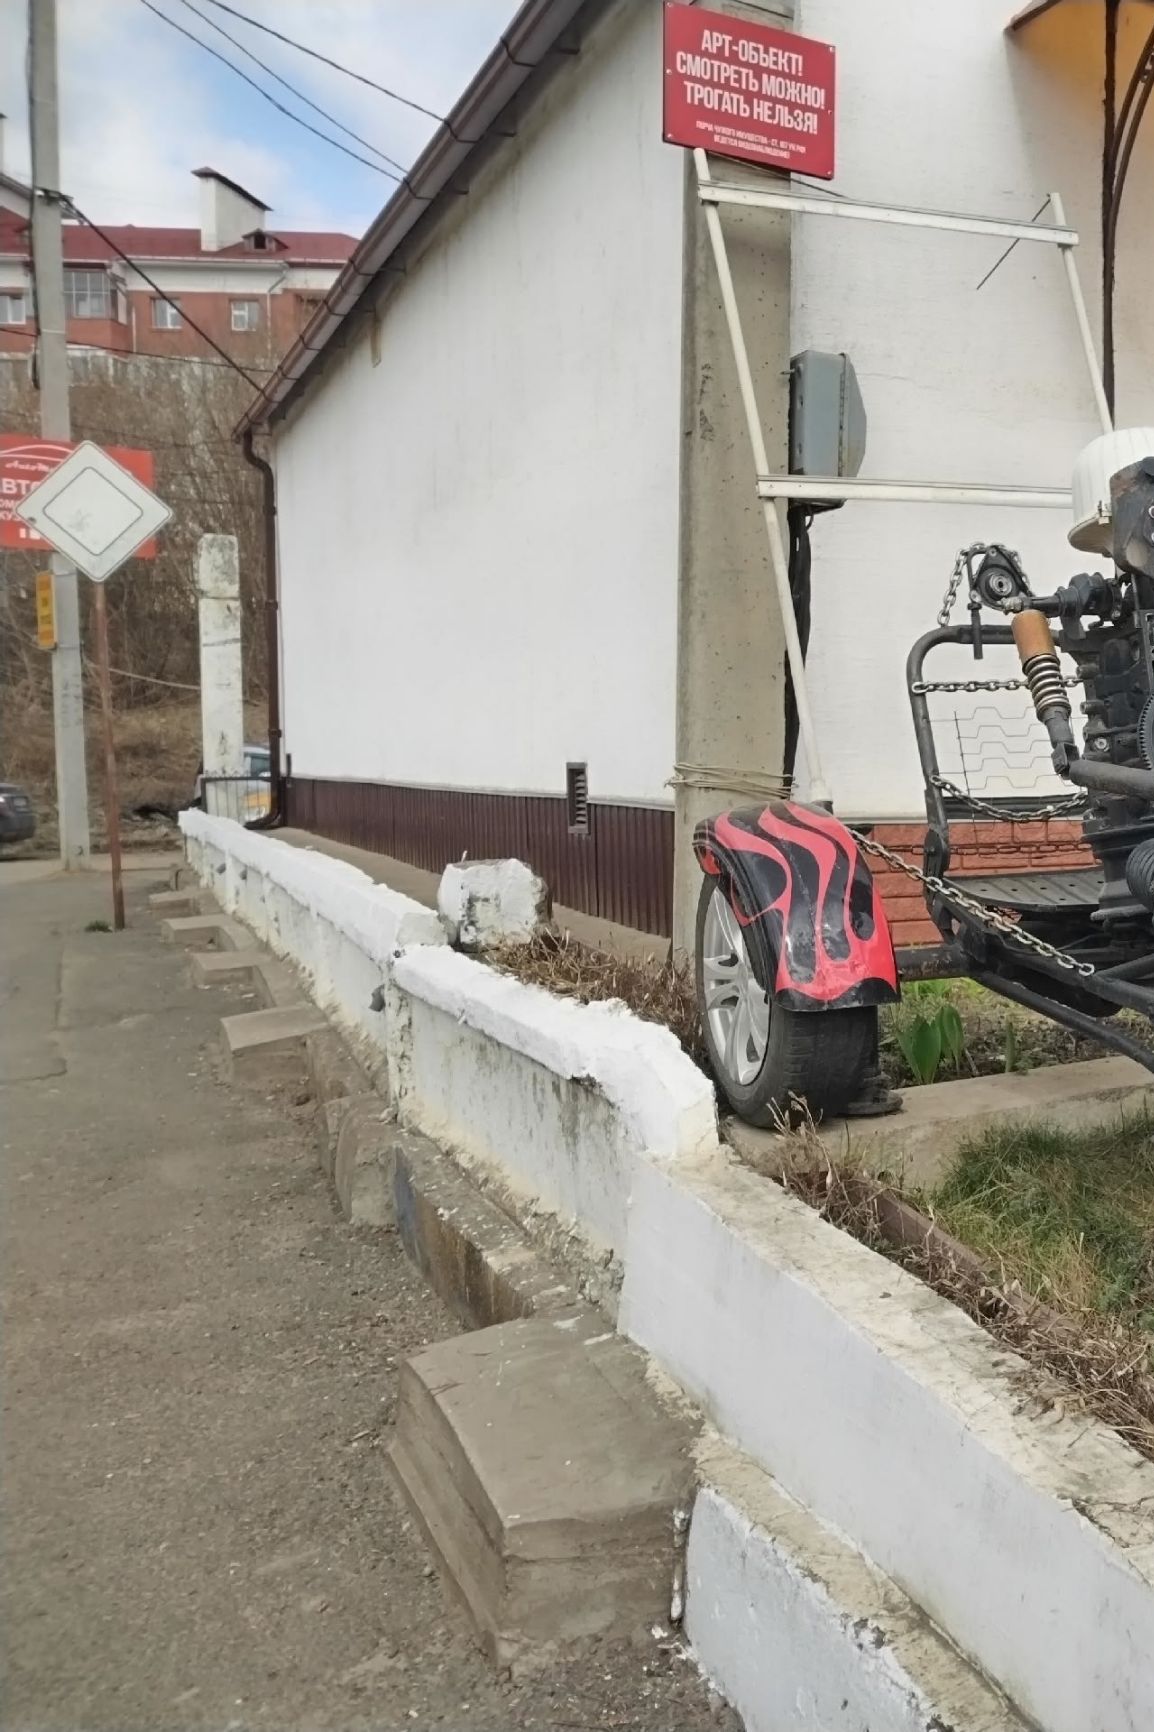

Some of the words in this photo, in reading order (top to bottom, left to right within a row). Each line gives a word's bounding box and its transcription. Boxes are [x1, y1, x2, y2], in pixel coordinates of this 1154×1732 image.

[701, 29, 803, 76] АРТ-ОБЪЕКТ!
[676, 51, 759, 92] СМОТРЕТЬ
[762, 73, 825, 110] МОЖНО!
[684, 81, 750, 117] ТРОГАТЬ
[753, 98, 818, 134] НЕЛЬЗЯ!
